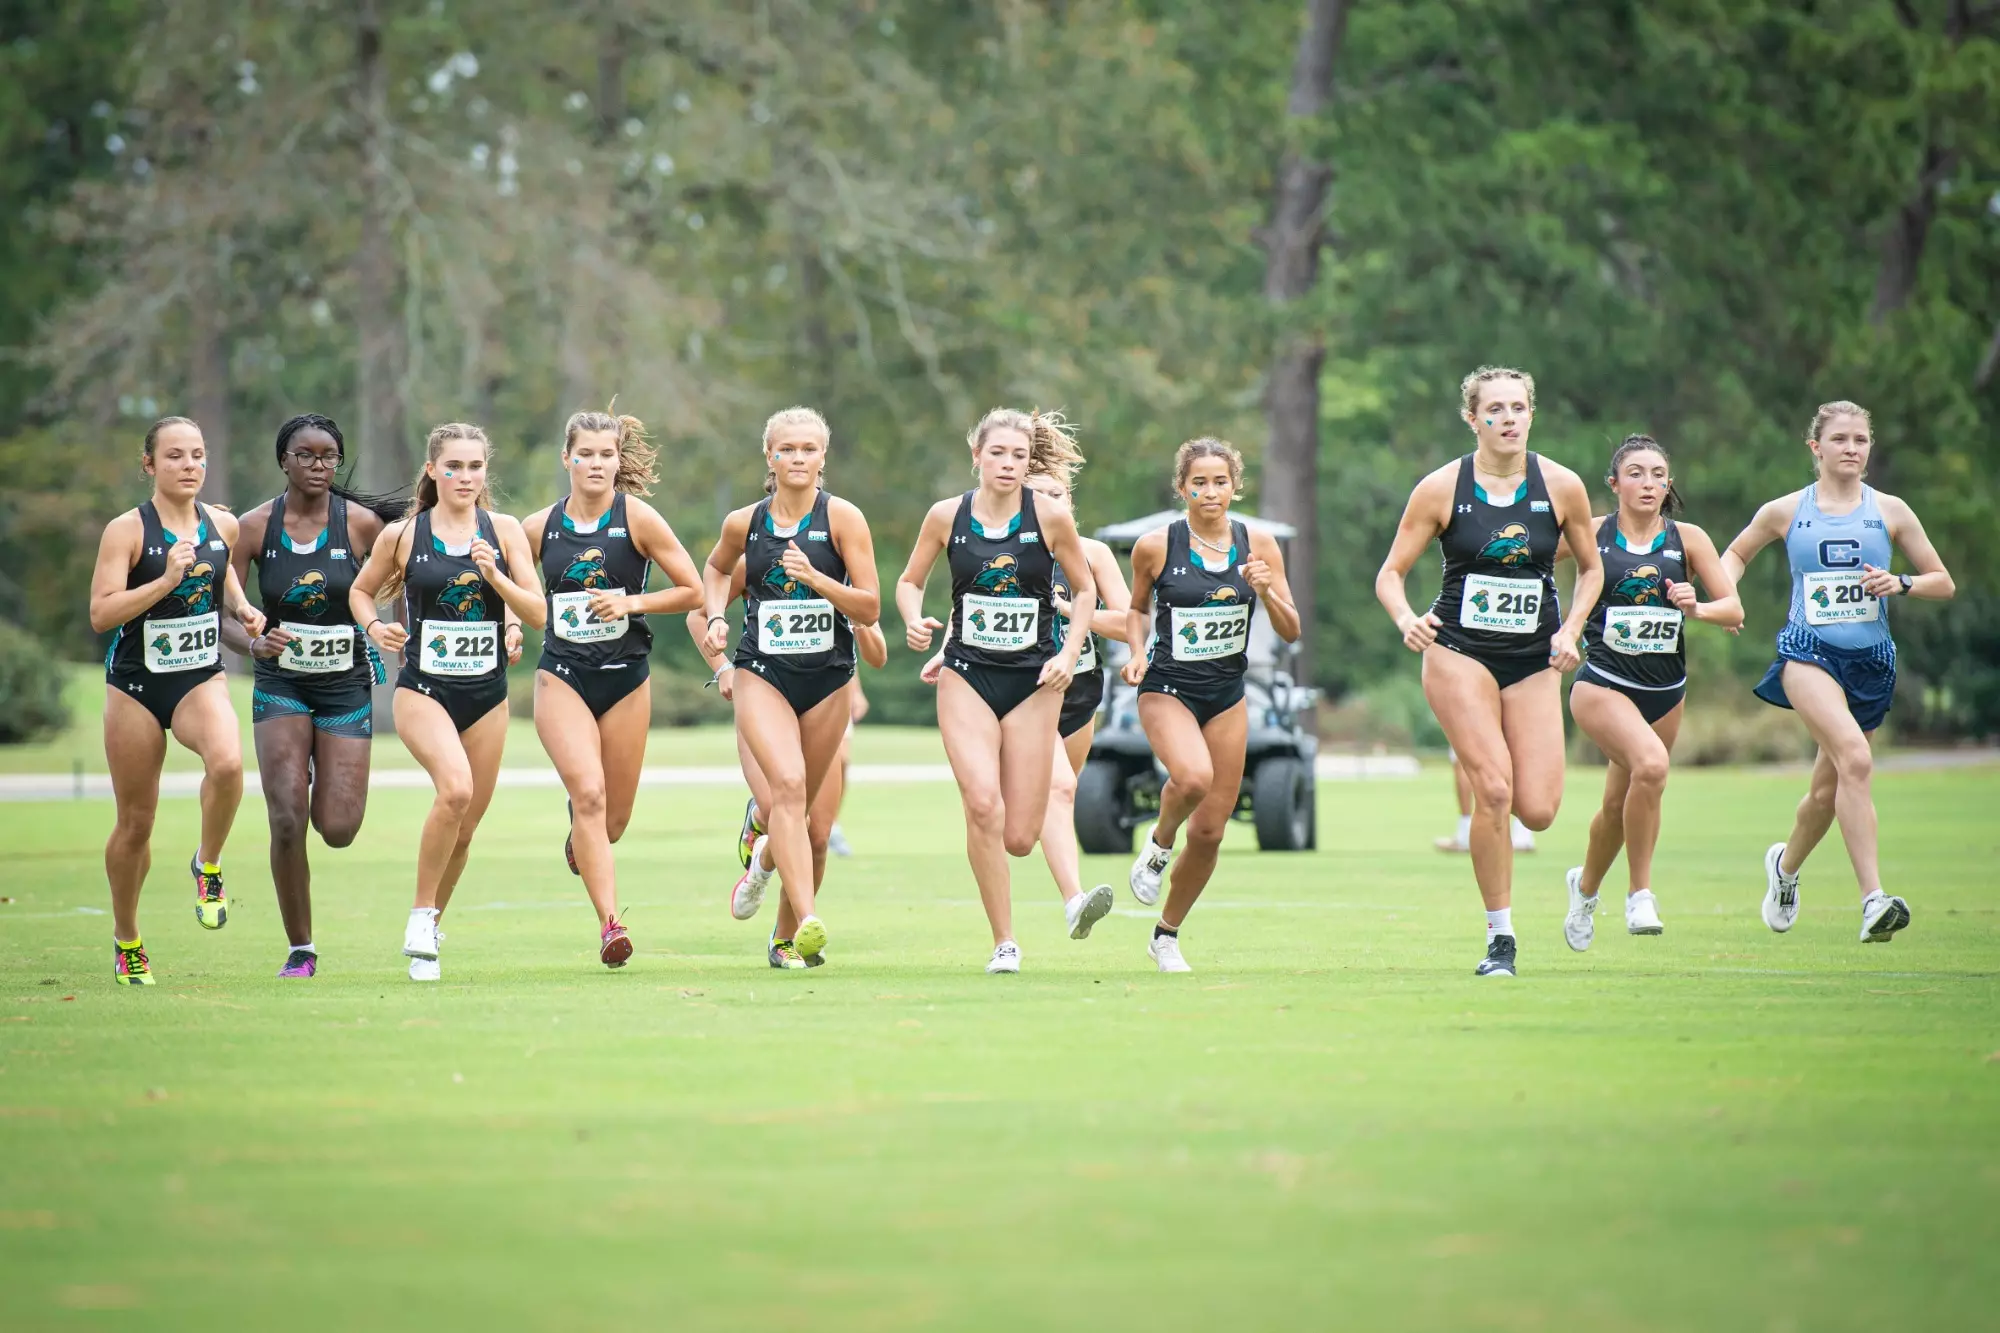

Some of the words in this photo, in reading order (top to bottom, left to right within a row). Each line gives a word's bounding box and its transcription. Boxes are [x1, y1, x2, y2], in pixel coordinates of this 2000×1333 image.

[1817, 538, 1861, 569] C
[1496, 593, 1538, 614] 216
[790, 613, 832, 634] 220
[994, 612, 1035, 632] 217
[1204, 618, 1246, 640] 222
[1473, 614, 1512, 626] CONWAY,
[179, 627, 217, 652] 218
[566, 628, 604, 638] CONWAY,
[972, 633, 1010, 644] CONWAY,
[1638, 621, 1678, 640] 215
[310, 638, 350, 656] 213
[455, 636, 494, 656] 212
[1614, 639, 1652, 650] CONWAY,
[158, 656, 196, 666] CONWAY,
[290, 658, 327, 666] CONWAY,
[432, 660, 472, 668] CONWAY,
